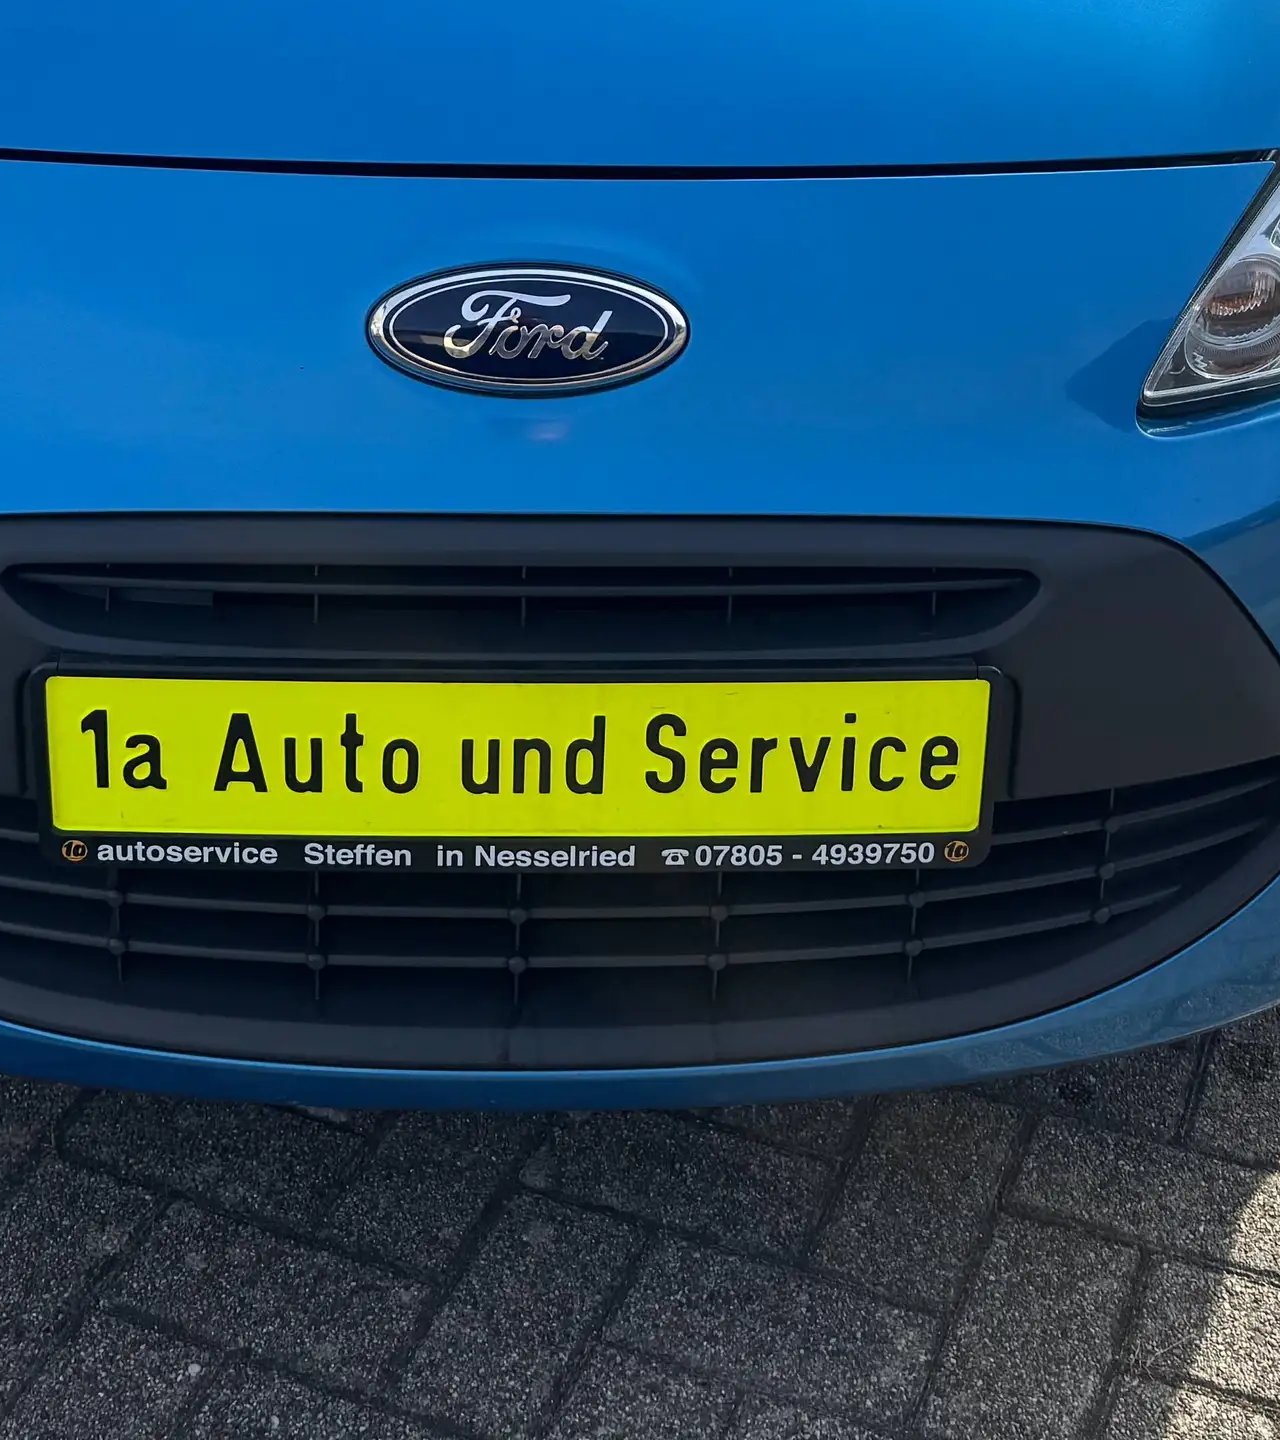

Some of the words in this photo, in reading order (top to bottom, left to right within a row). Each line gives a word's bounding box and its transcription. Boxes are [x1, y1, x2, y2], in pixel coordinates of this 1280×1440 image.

[443, 289, 613, 360] Ford
[80, 709, 168, 790] 1a
[213, 712, 420, 794] Auto
[461, 715, 607, 795] und
[644, 712, 960, 794] Service
[96, 841, 279, 864] autoservice
[303, 841, 413, 866] Steffen
[436, 845, 464, 867] in
[475, 844, 636, 868] Nesselried
[694, 844, 783, 867] 07805
[811, 841, 936, 865] 4939750
